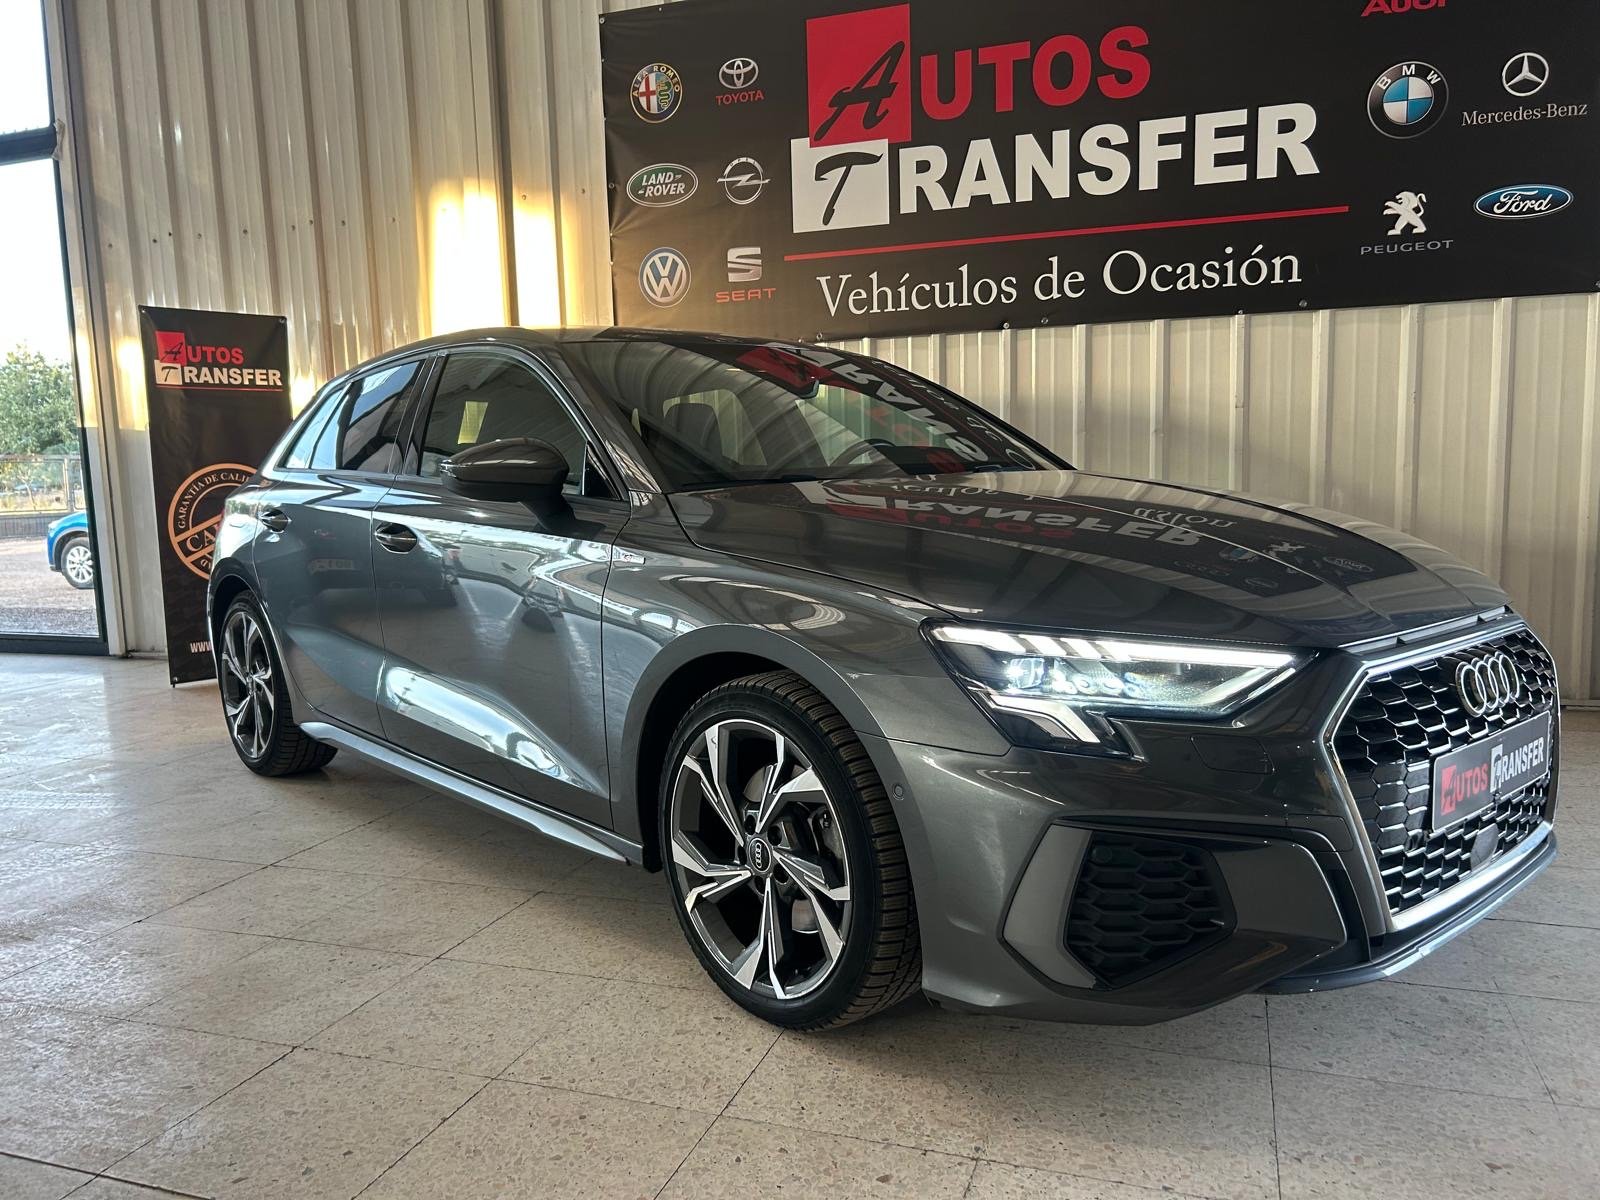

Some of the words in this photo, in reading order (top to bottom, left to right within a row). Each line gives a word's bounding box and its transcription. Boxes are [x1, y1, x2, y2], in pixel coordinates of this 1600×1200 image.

[653, 65, 681, 93] ROMEO
[812, 25, 1151, 142] AUTOS
[715, 89, 765, 106] TOYOTA
[1461, 103, 1588, 127] Mercedes-Benz
[814, 102, 1320, 226] TRANSFER
[1493, 189, 1554, 214] Ford
[1360, 239, 1454, 256] PEUGEOT
[816, 263, 1018, 317] Vehículos
[1033, 256, 1086, 301] de
[1102, 244, 1302, 296] Ocasión
[715, 287, 777, 304] SEAT
[160, 341, 245, 366] AUTOS
[160, 365, 283, 386] TRANSFER
